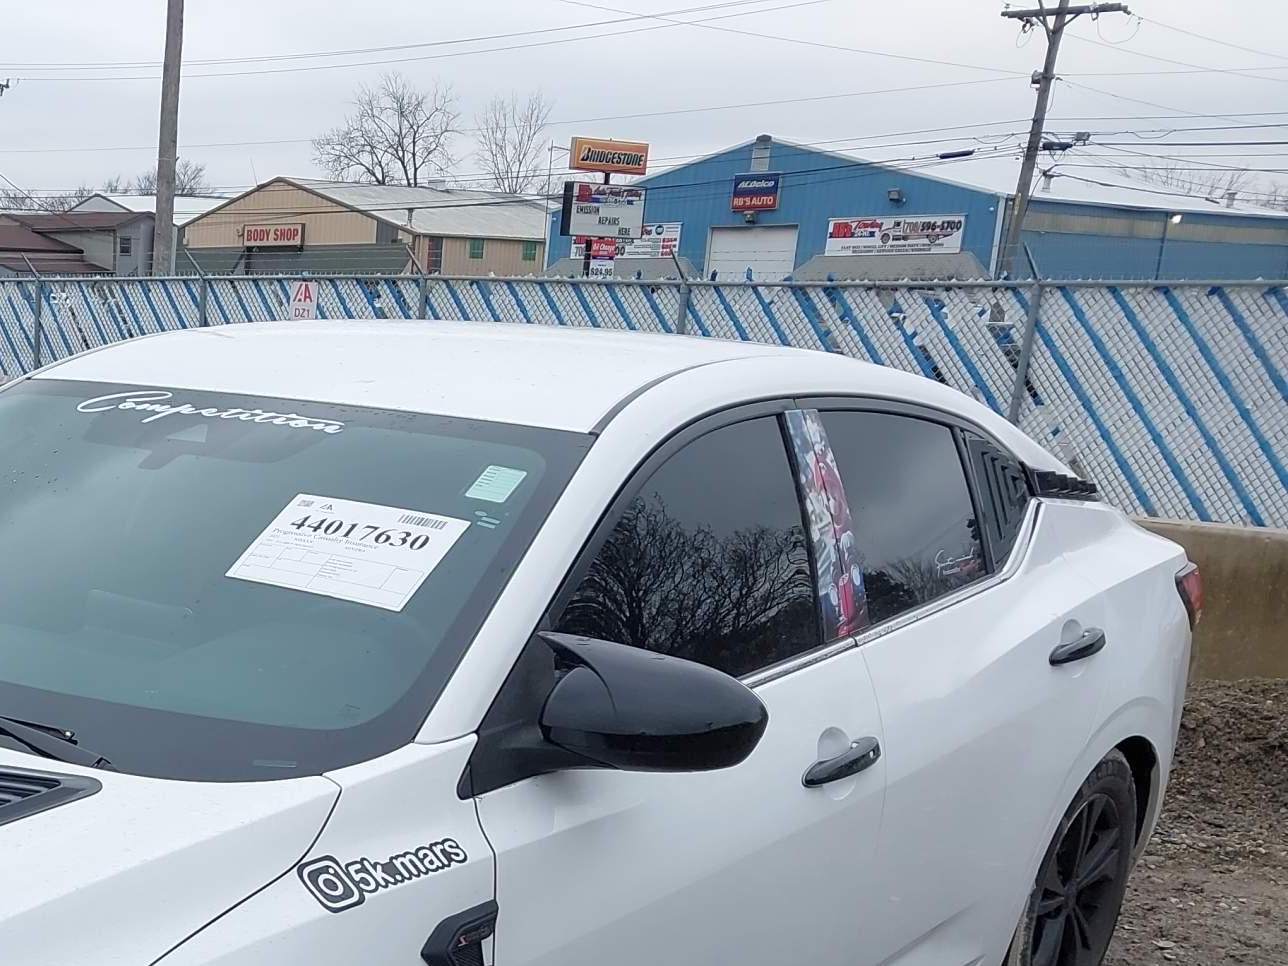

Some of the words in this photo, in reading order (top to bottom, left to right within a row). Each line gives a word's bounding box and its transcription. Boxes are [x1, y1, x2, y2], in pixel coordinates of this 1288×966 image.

[580, 147, 645, 166] BRIDGESTONE
[752, 196, 774, 205] AUTO
[576, 206, 600, 217] EMISSION
[598, 217, 620, 226] REPAIRS
[246, 229, 272, 242] BODY
[273, 228, 299, 241] SHOP
[617, 227, 631, 237] HERE
[294, 307, 310, 318] DZ1
[76, 390, 345, 433] Competition
[289, 514, 431, 551] 44017630
[346, 839, 467, 892] 5k.mars
